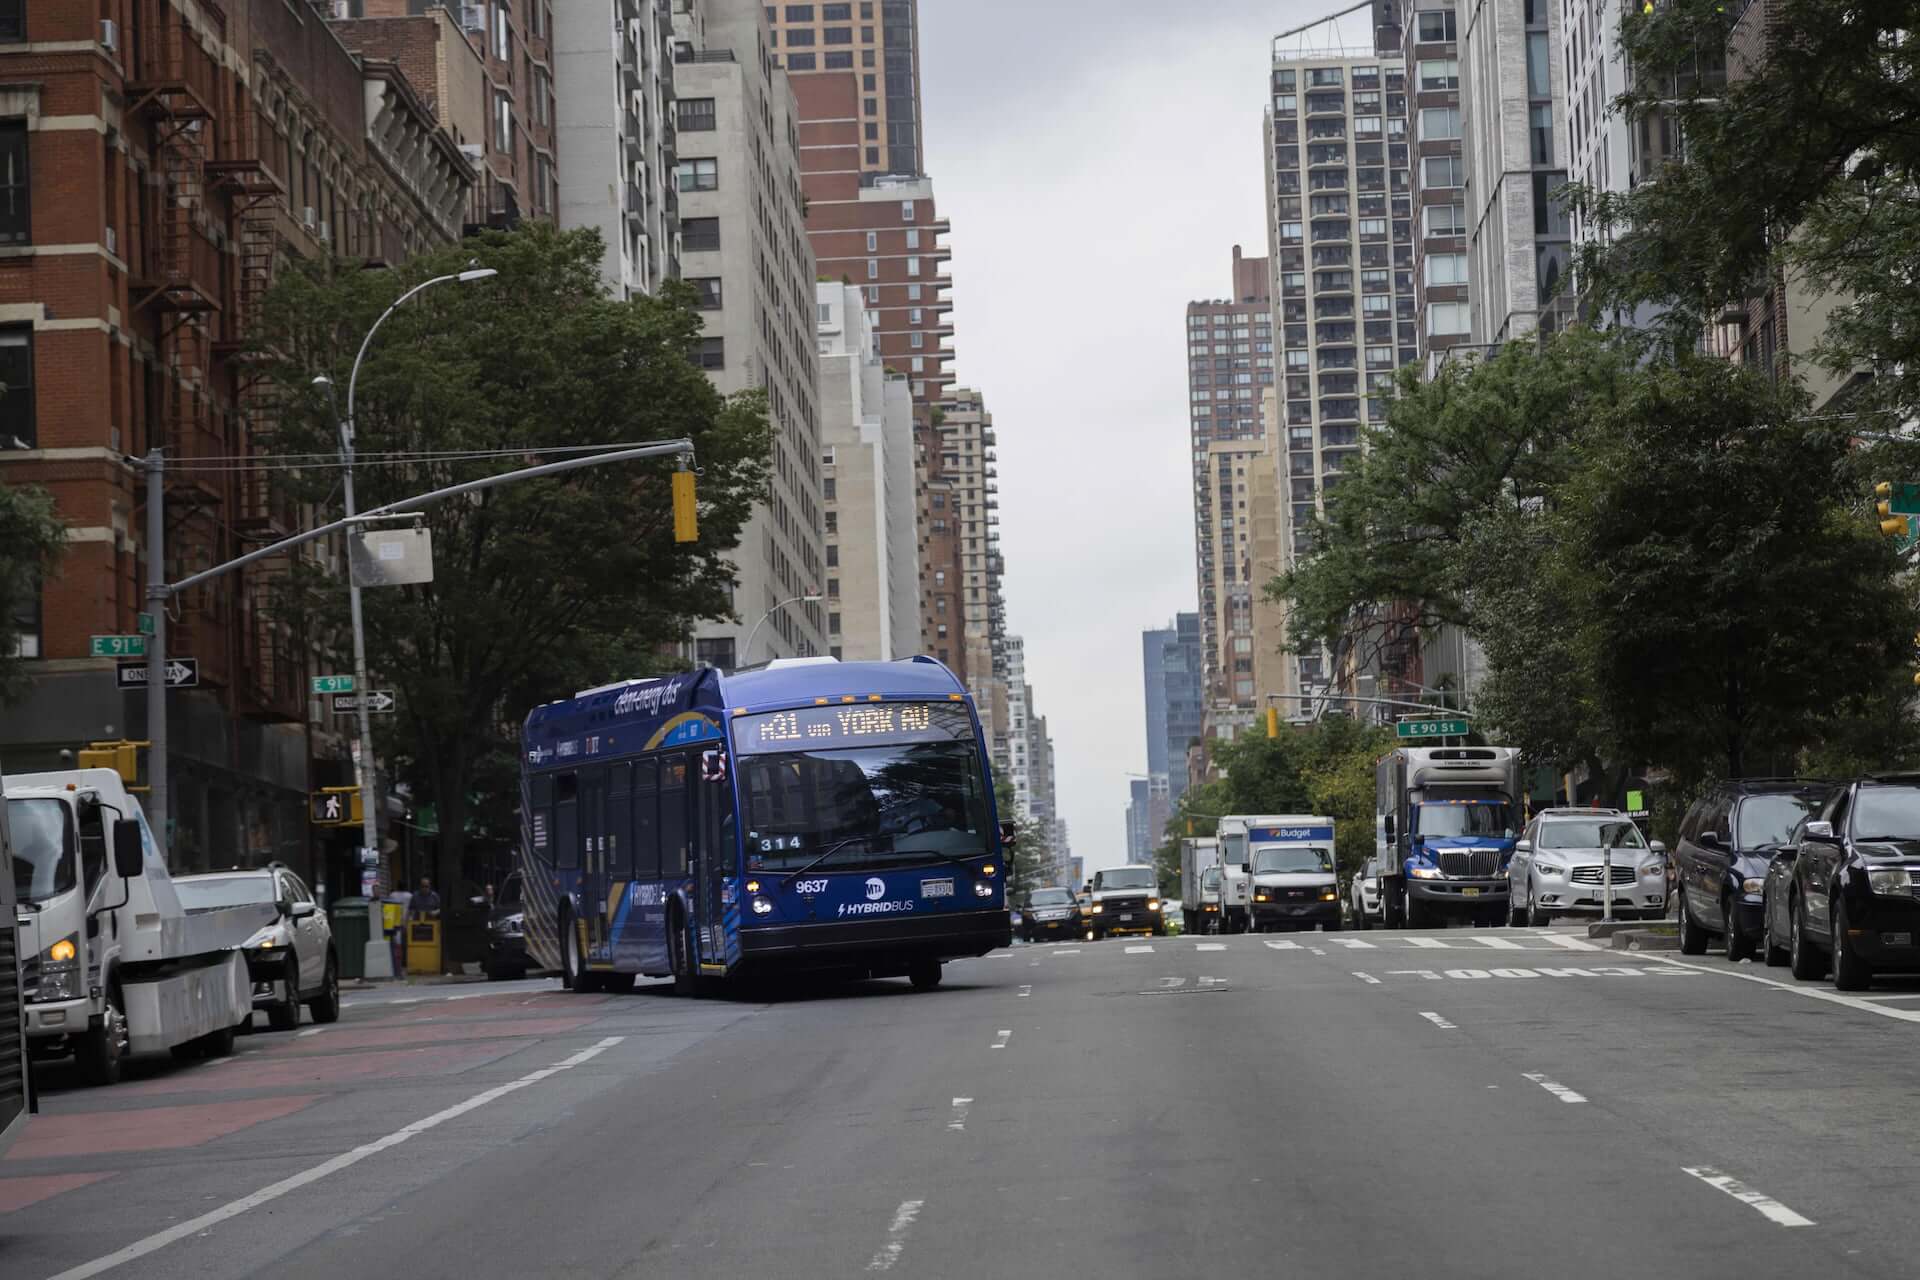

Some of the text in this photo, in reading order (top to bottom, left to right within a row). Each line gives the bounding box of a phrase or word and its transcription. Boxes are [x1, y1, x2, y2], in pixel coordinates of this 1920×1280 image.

[94, 638, 104, 653] E
[112, 638, 128, 653] 91
[314, 680, 321, 691] E
[328, 679, 342, 689] 91
[837, 708, 894, 735] YORK
[1410, 722, 1455, 734] E 90 St
[1280, 829, 1311, 839] Budget
[796, 880, 828, 893] 9637
[1385, 967, 1704, 980] SCHOOL
